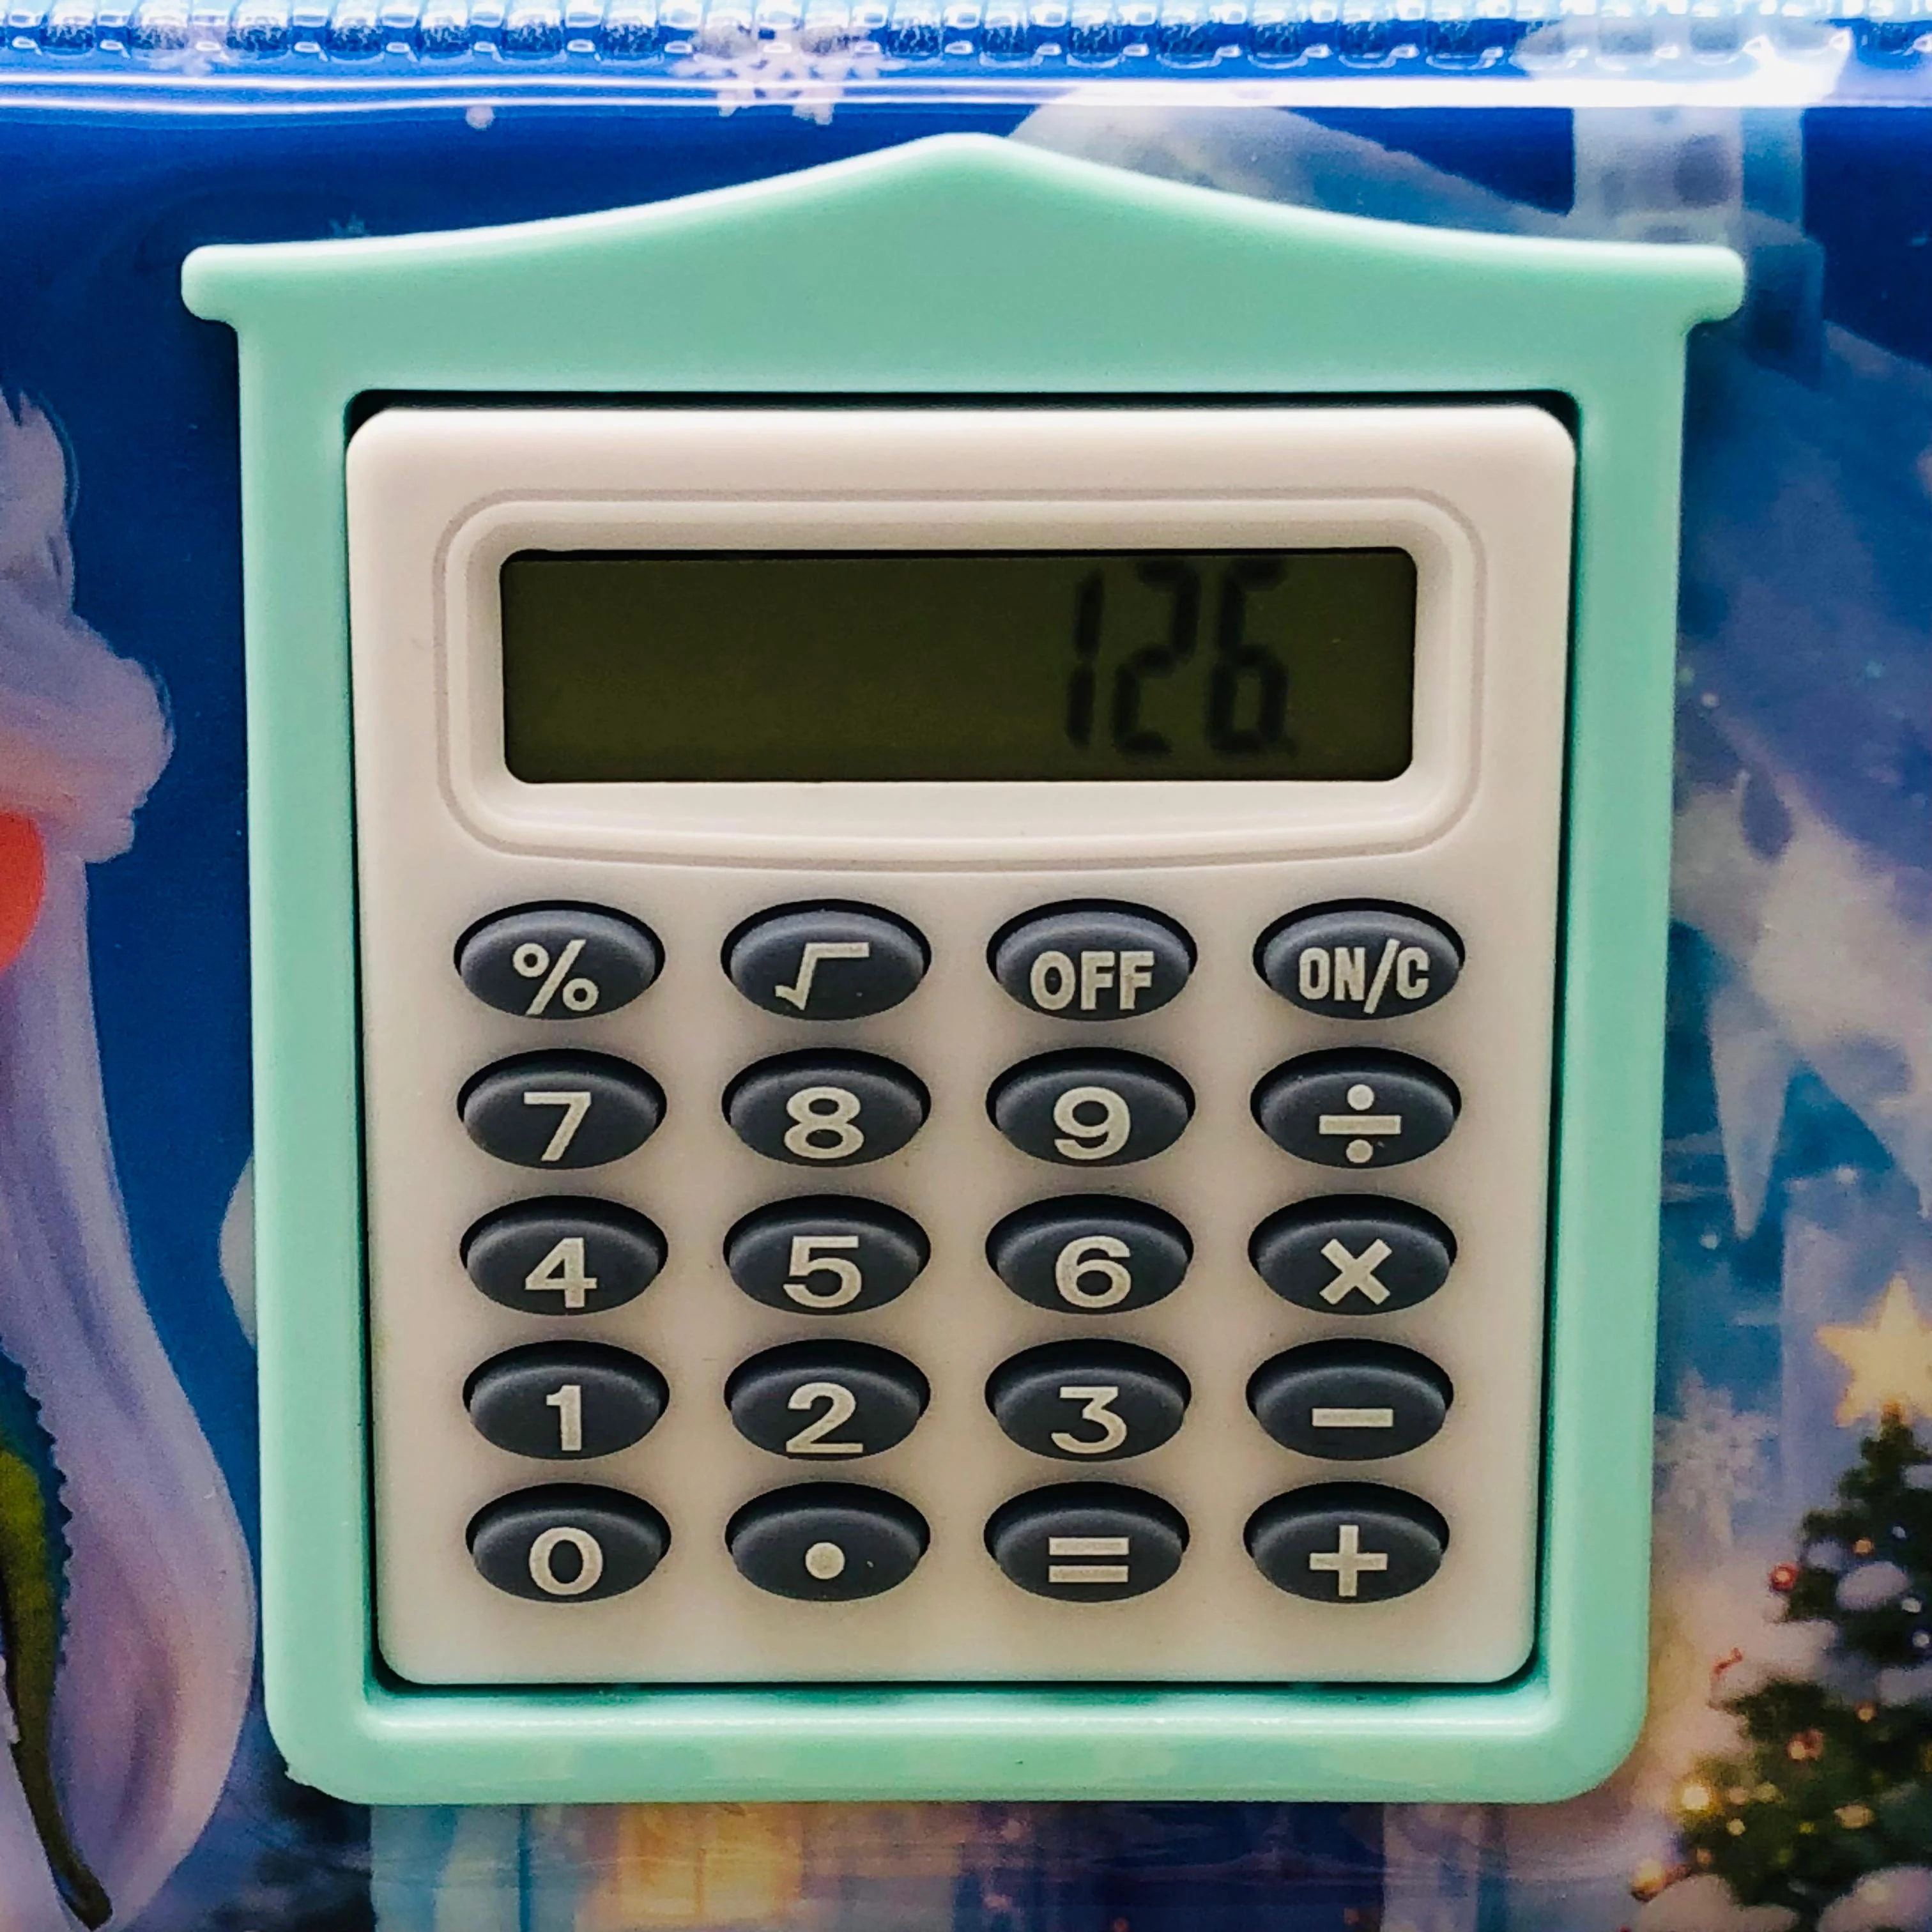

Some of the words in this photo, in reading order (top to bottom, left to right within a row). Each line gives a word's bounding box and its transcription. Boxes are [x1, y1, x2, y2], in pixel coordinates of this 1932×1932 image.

[513, 940, 598, 1015] %
[1030, 951, 1154, 1011] OFF
[1299, 939, 1428, 1013] ON/C
[524, 1091, 590, 1161] 7
[785, 1087, 863, 1159] 8
[1054, 1086, 1130, 1160] 9
[1320, 1084, 1400, 1163] ÷
[525, 1238, 597, 1308] 4
[784, 1236, 862, 1308] 5
[1055, 1236, 1131, 1308] 6
[546, 1384, 582, 1451] 1
[786, 1383, 862, 1453] 2
[1052, 1387, 1127, 1453] 3
[530, 1528, 602, 1595] 0
[1049, 1537, 1129, 1583] =
[1310, 1524, 1388, 1597] +
